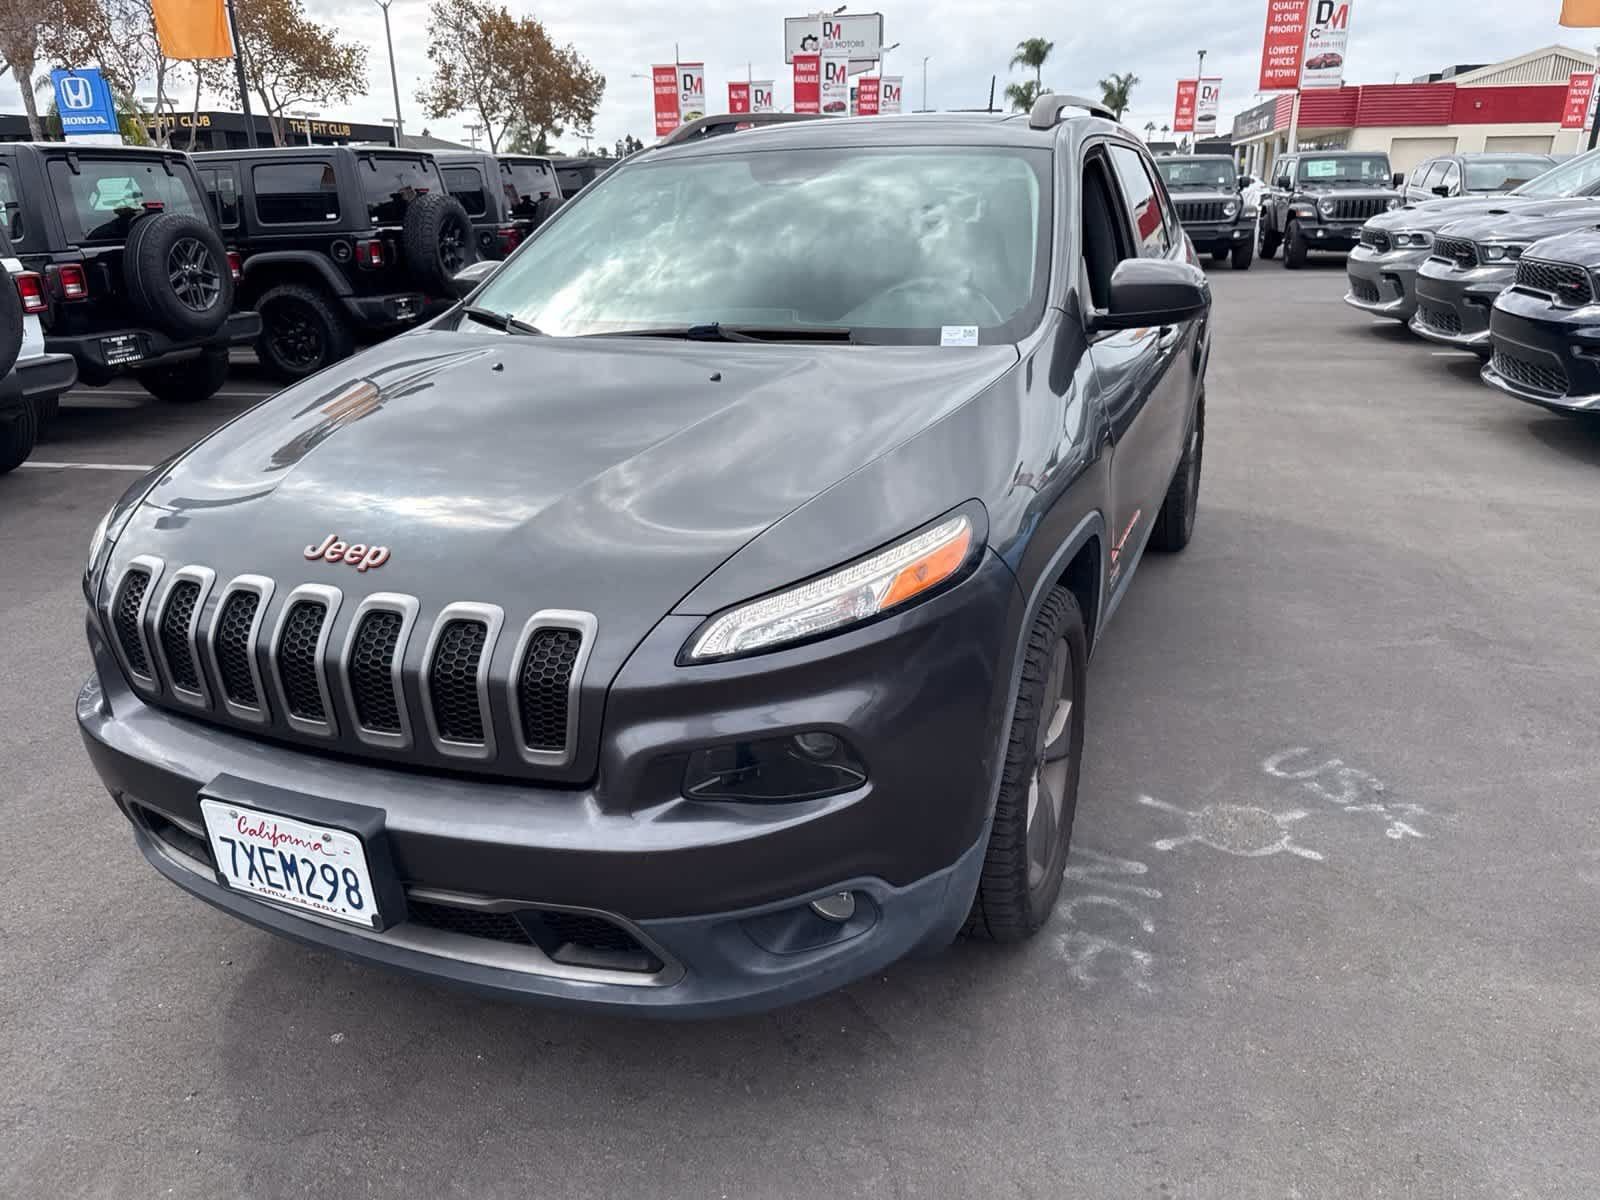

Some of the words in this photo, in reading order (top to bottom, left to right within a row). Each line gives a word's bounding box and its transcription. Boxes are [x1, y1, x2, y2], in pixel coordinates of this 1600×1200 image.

[1272, 1, 1305, 11] QUALITY
[1274, 13, 1282, 22] IS
[1283, 12, 1300, 22] OUR
[1269, 25, 1303, 35] PRIORITY
[835, 39, 865, 49] MOTORS
[1268, 45, 1299, 55] LOWEST
[1270, 57, 1295, 66] PRICES
[1265, 69, 1274, 78] IN
[1274, 68, 1297, 78] TOWN
[62, 116, 108, 125] HONDA
[180, 115, 211, 127] CLUB
[312, 122, 328, 135] FIT
[329, 124, 352, 136] CLUB
[303, 533, 391, 573] Jeep
[236, 815, 336, 857] California
[219, 835, 364, 910] 7XEM298
[258, 886, 340, 914] dmv.ca.gov
